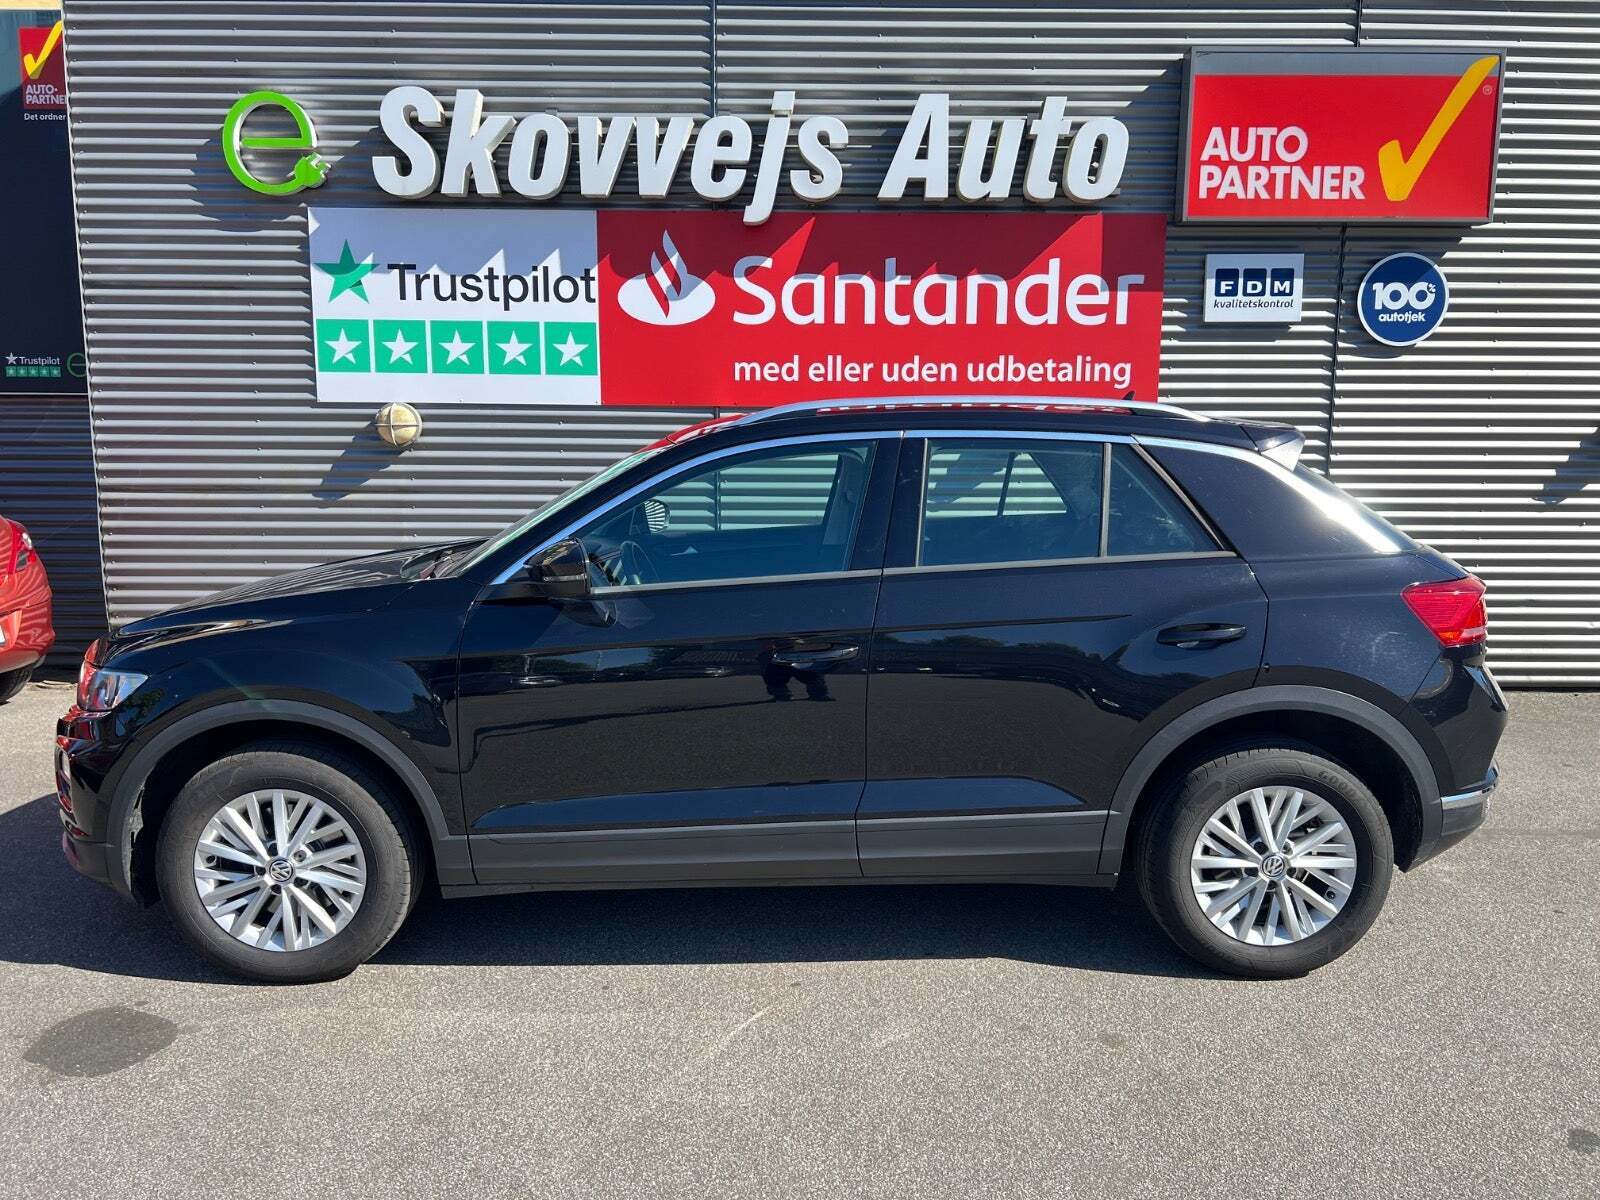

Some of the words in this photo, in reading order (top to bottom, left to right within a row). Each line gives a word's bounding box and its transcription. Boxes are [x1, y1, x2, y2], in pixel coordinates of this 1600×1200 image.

[371, 86, 850, 226] Skovvejs
[877, 93, 1131, 202] Auto
[1201, 126, 1308, 161] AUTO
[1198, 165, 1366, 200] PARTNER
[387, 263, 597, 311] Trustpilot
[732, 255, 1145, 326] Santander
[1213, 298, 1294, 309] kvalitetskontrol
[1219, 280, 1291, 295] FDM
[1378, 311, 1426, 324] autotjek
[19, 356, 60, 366] Trustpilot
[733, 355, 801, 383] med
[807, 355, 875, 383] eller
[881, 356, 959, 384] uden
[966, 356, 1133, 390] udbetaling
